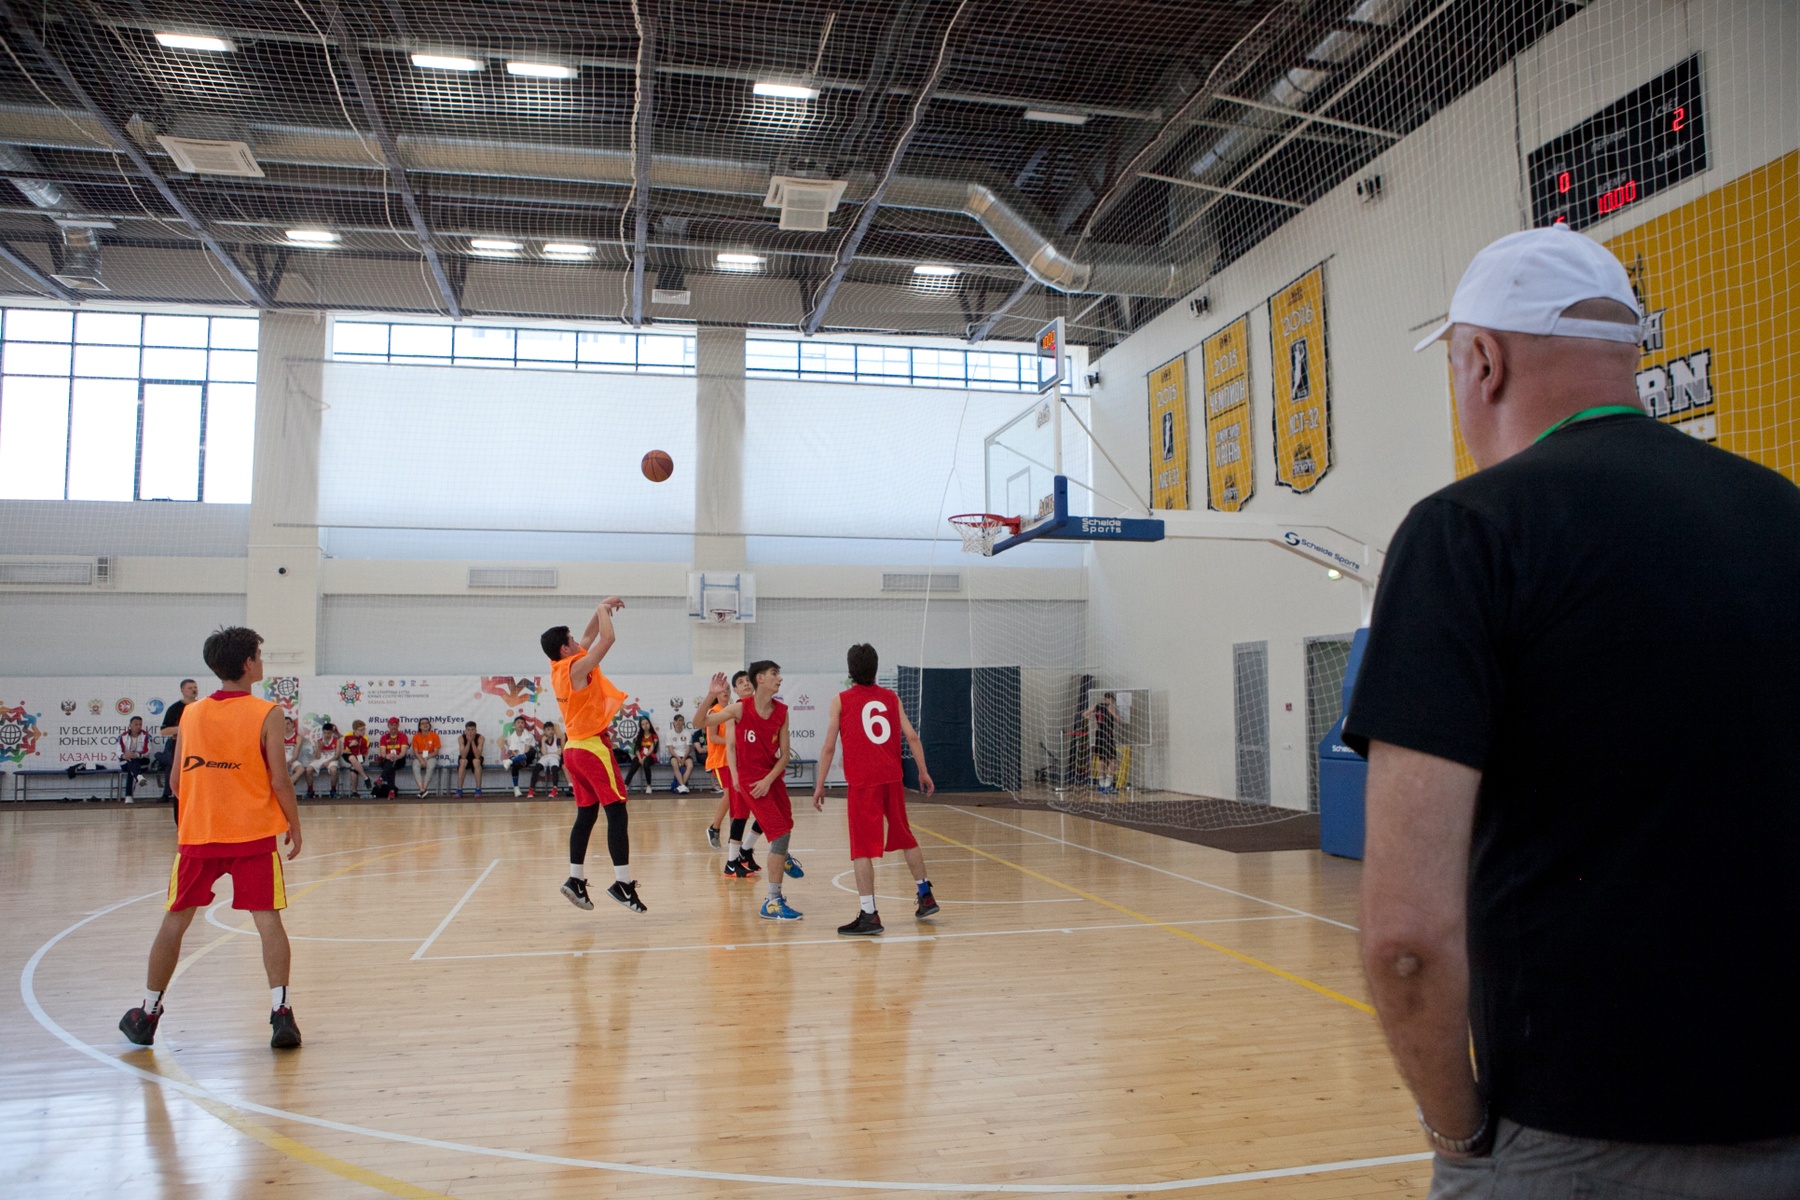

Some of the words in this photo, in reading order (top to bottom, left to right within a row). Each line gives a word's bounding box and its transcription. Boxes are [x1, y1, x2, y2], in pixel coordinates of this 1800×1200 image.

[1673, 107, 1684, 131] 2
[1559, 171, 1570, 194] 0
[1282, 303, 1313, 337] 2016
[1213, 348, 1238, 378] 2015
[1209, 379, 1245, 415] ЧЕМПИОН
[1082, 525, 1121, 534] Sports
[1334, 553, 1360, 570] Sports
[60, 726, 72, 735] IV
[862, 701, 892, 745] 6
[59, 737, 98, 746] ЮНЫХ
[60, 752, 108, 762] КАЗАНЬ
